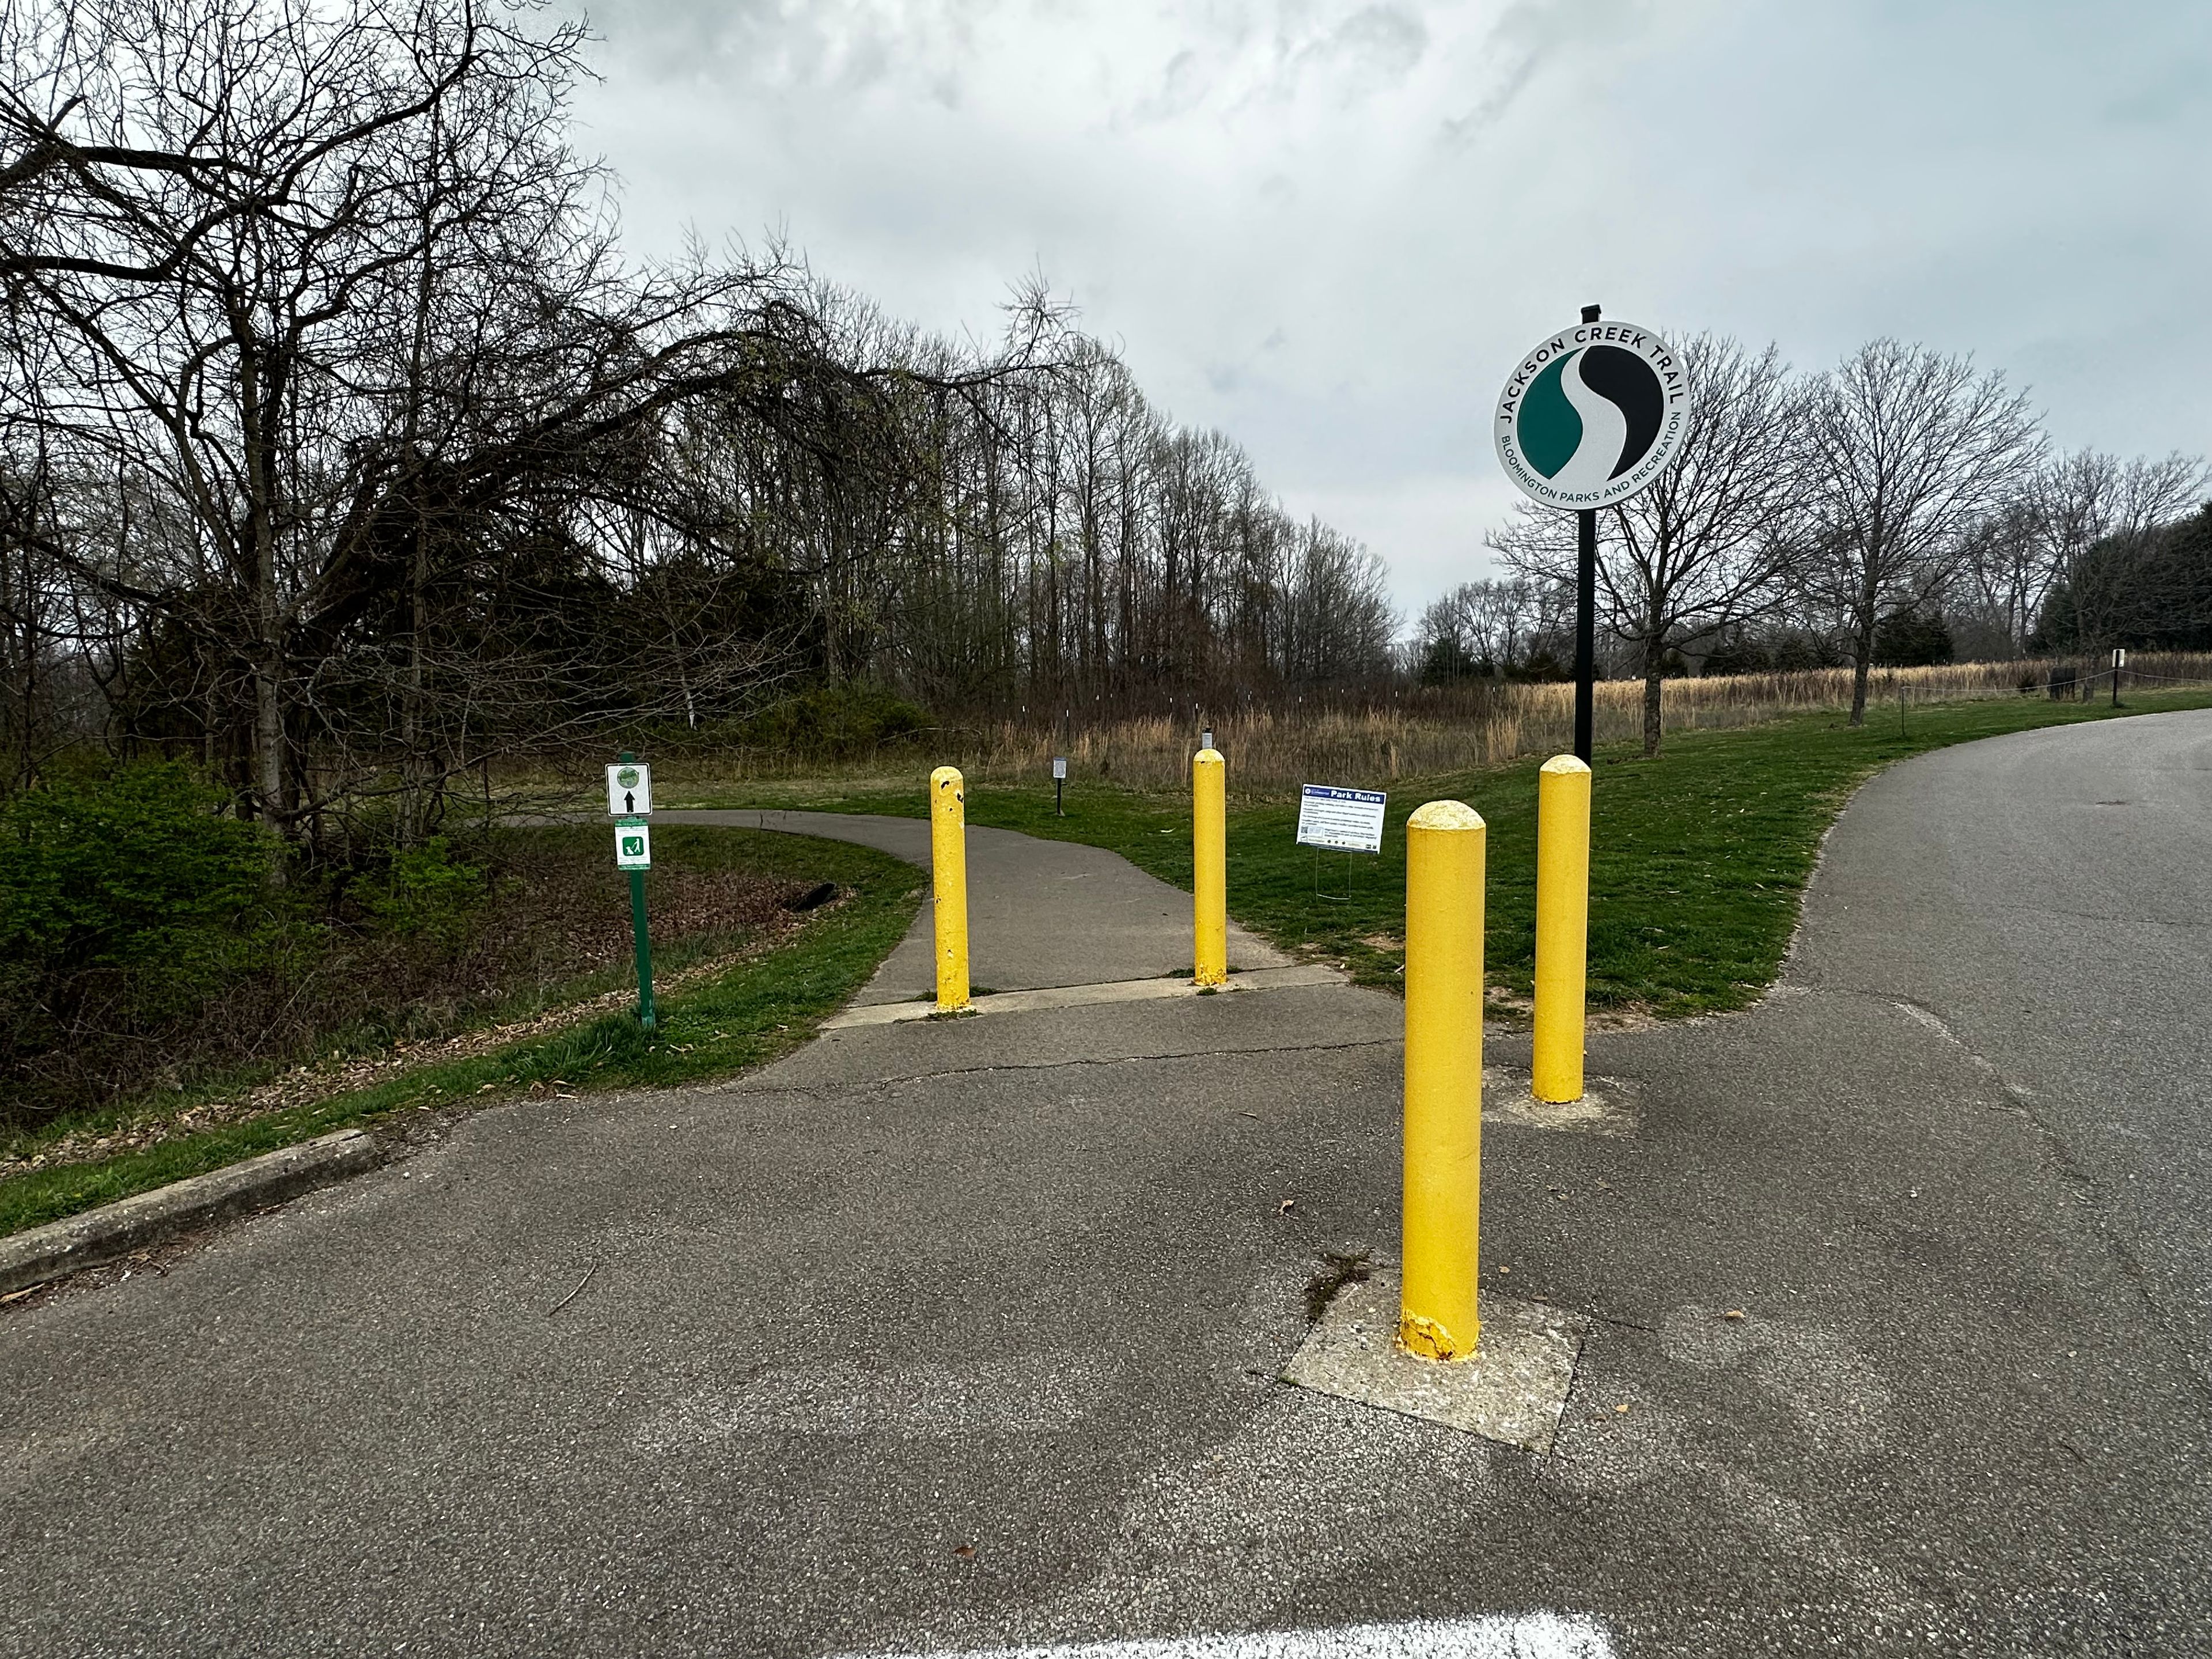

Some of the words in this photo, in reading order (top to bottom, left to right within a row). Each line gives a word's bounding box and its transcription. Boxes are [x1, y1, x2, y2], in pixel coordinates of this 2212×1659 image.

[1500, 338, 1565, 423] JACKSON
[1574, 327, 1647, 349] CREEK
[1649, 345, 1684, 404] TRAIL
[1502, 435, 1558, 499] BLOOMINGTON
[1560, 492, 1600, 502] PARKS
[1604, 481, 1630, 498] AND
[1632, 411, 1681, 483] RECREATION
[1331, 790, 1352, 800] Park
[1355, 793, 1380, 802] Rules
